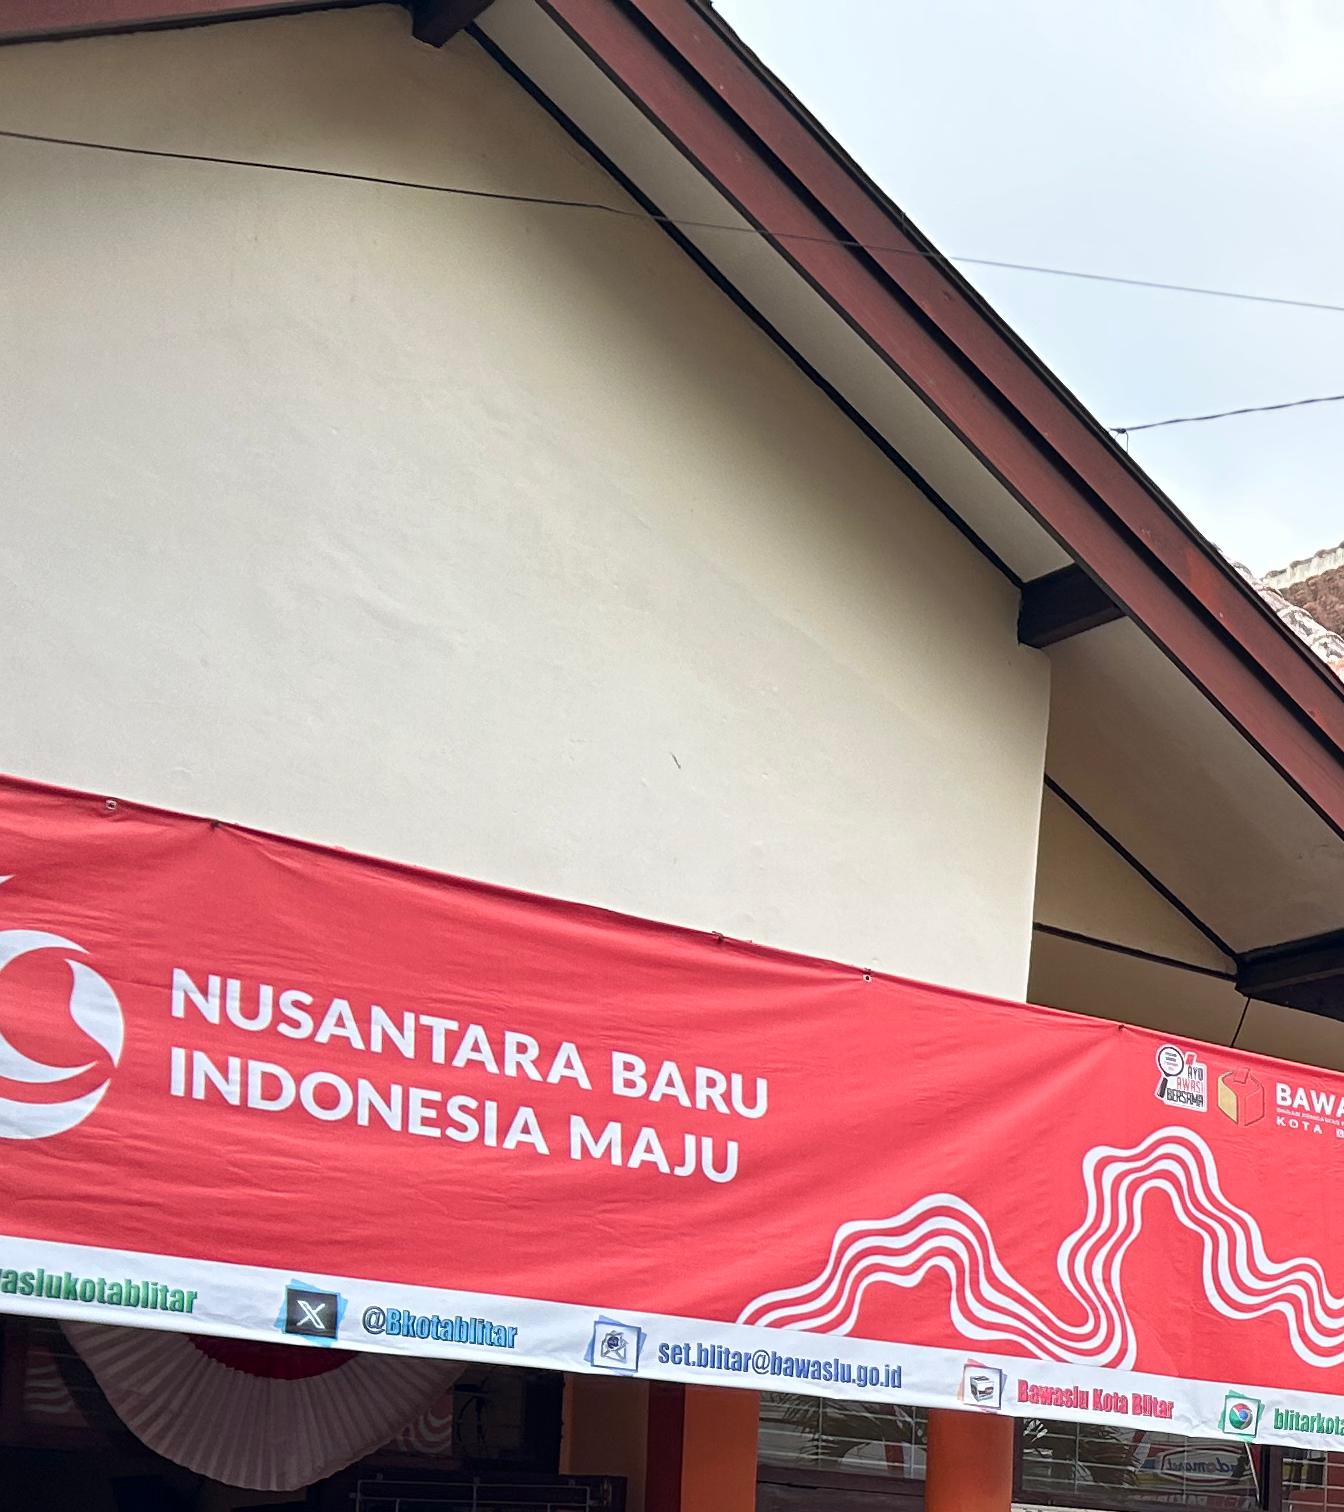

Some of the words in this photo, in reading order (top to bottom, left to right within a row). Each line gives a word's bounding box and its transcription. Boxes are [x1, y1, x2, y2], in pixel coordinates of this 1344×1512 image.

[170, 967, 591, 1090] NUSANTARA
[611, 1050, 769, 1118] BARU
[1188, 1065, 1204, 1081] AYO
[169, 1047, 549, 1156] INDONESIA
[569, 1114, 740, 1183] MAJU
[1276, 1115, 1323, 1135] KOTA
[0, 1267, 198, 1314] aslukotablitar
[362, 1305, 519, 1348] @Bkotablitar
[658, 1342, 902, 1388] set.blitar@bawaslu.go.id
[1017, 1379, 1089, 1410] Bawaslu
[1092, 1388, 1129, 1414] Kota
[1131, 1393, 1175, 1420] Blitar
